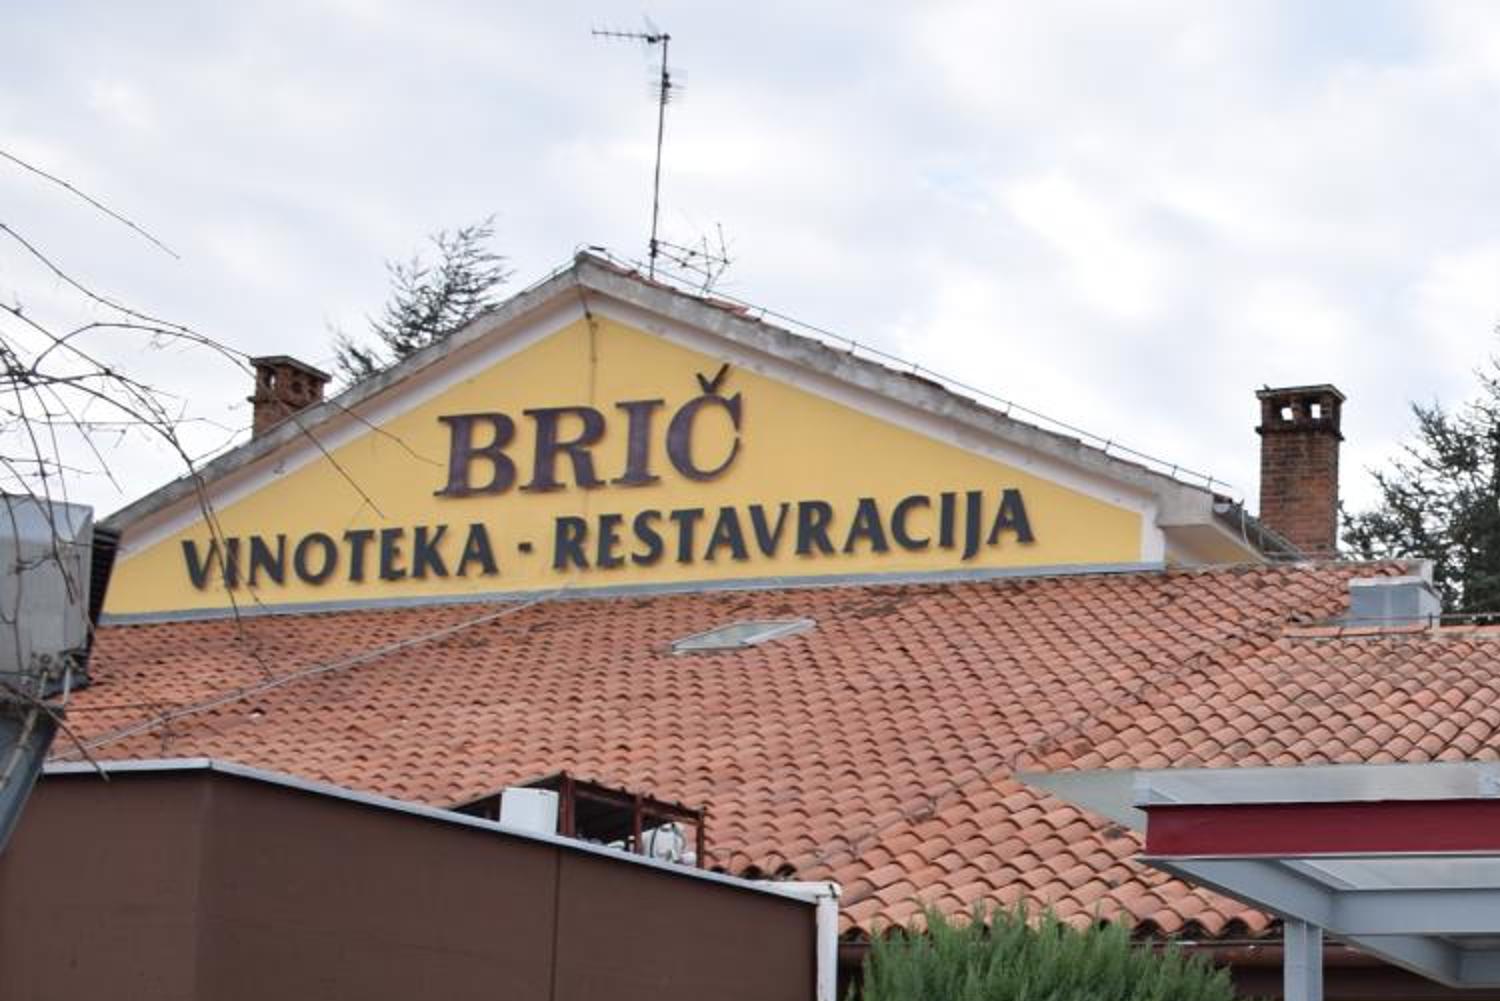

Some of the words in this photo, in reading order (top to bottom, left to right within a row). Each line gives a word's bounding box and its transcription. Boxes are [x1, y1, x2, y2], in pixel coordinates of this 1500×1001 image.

[433, 363, 742, 500] BRIČ
[181, 522, 499, 594] VINOTEKA
[552, 488, 1036, 572] RESTAVRACIJA
